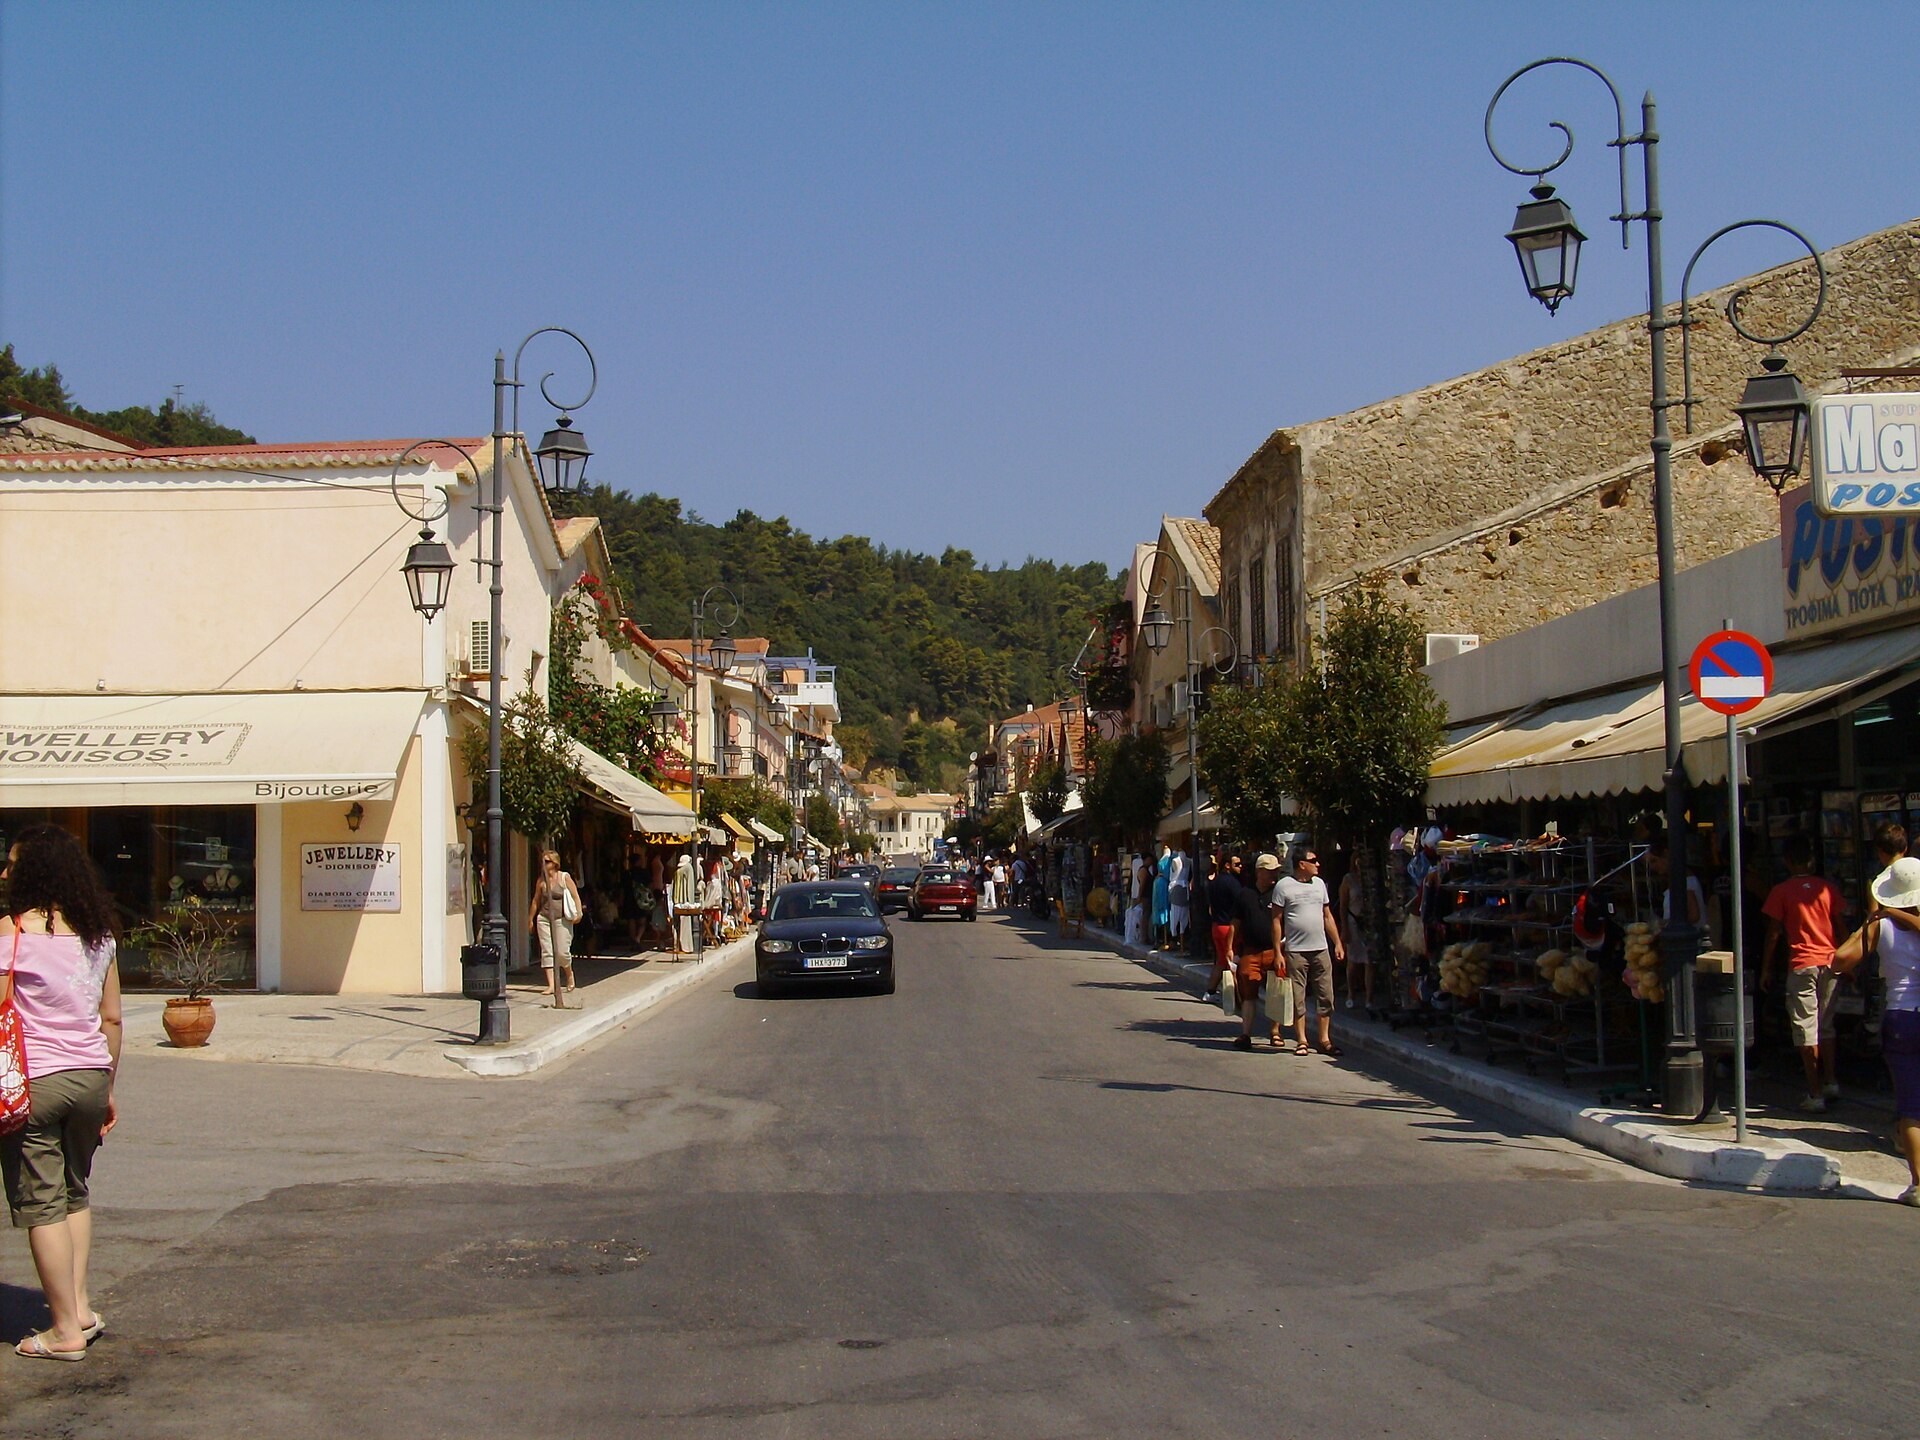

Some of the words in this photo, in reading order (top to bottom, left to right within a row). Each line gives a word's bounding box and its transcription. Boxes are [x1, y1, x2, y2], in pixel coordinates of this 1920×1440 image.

[1830, 482, 1920, 508] POS
[0, 730, 225, 747] WELLERY
[255, 782, 379, 799] Bijouterie
[306, 847, 395, 865] JEWELLERY
